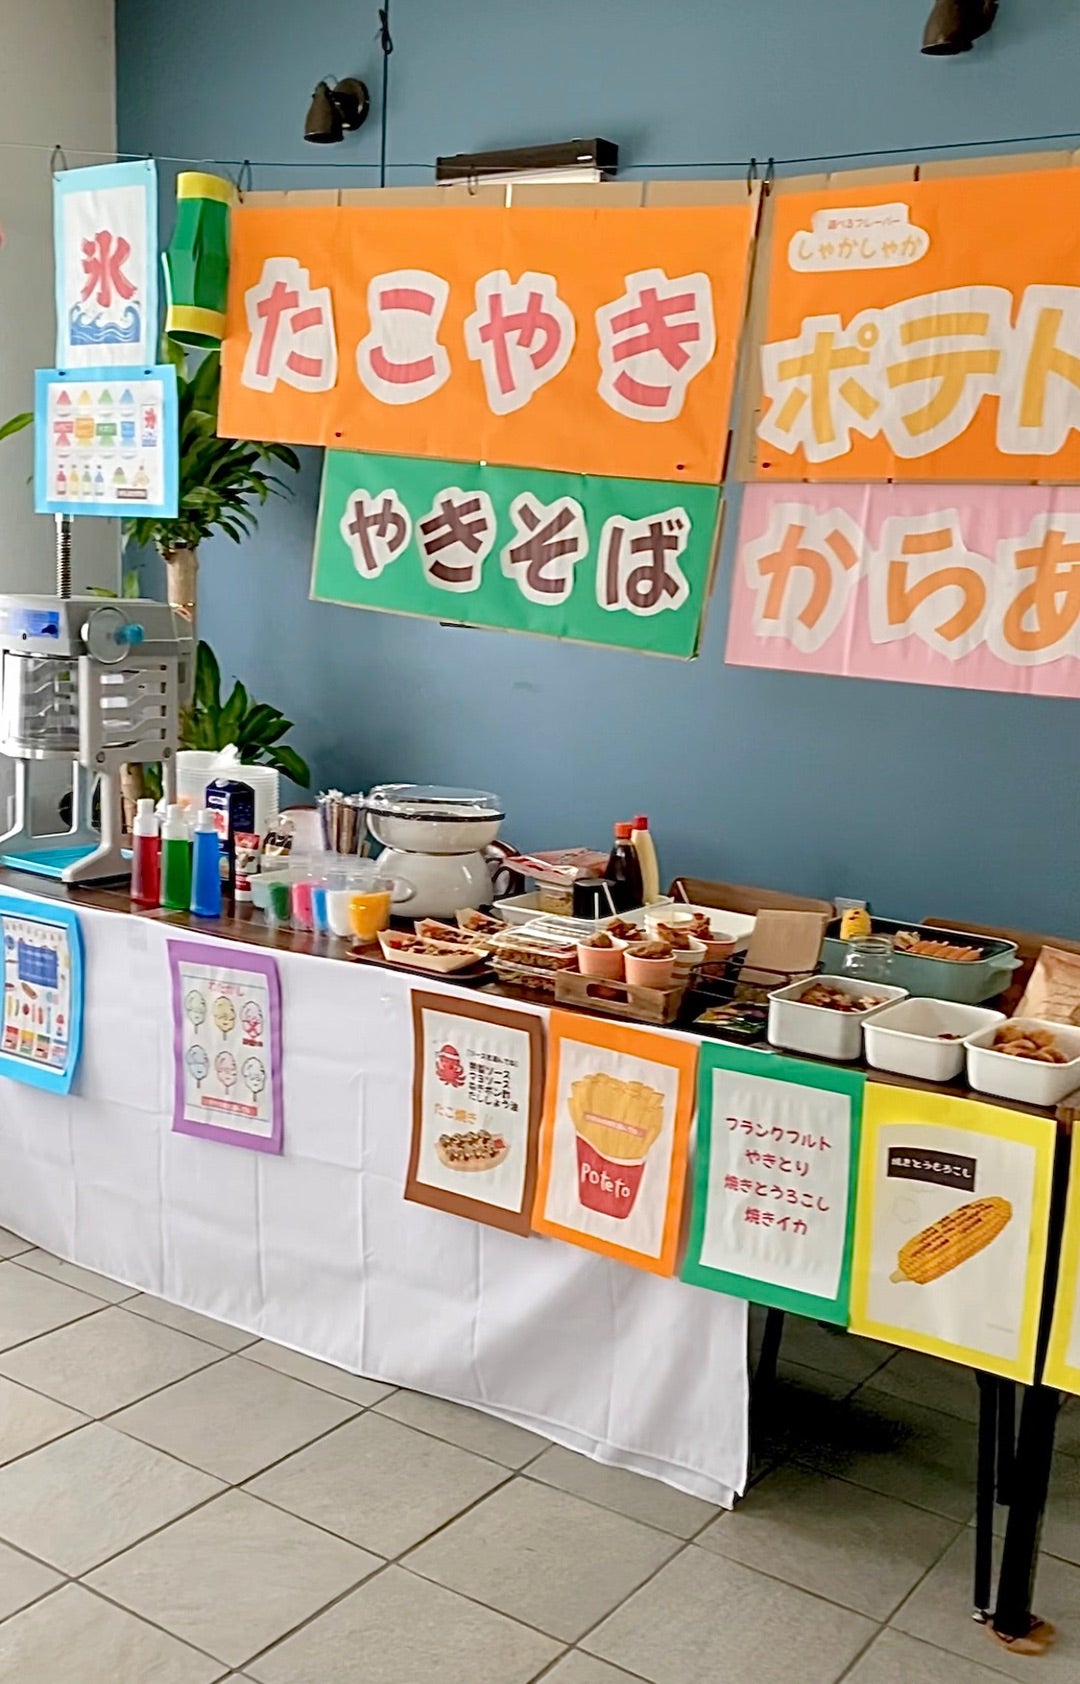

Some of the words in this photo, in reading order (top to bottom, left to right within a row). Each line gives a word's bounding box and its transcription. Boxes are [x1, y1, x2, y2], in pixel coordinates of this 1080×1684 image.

[798, 234, 923, 260] しゃかしゃか
[80, 230, 138, 308] 氷
[256, 281, 700, 408] たこやき
[777, 308, 1080, 444] ポテト
[349, 497, 684, 608] やきそば
[757, 524, 1080, 651] からあ
[726, 1118, 831, 1151] フランクフルト
[580, 1162, 630, 1198] Poteto
[745, 1149, 809, 1176] やきとり
[891, 1158, 971, 1178] 焼きとうもろこし
[724, 1174, 830, 1211] 焼きとうろこし
[744, 1207, 808, 1235] 焼きイカ
